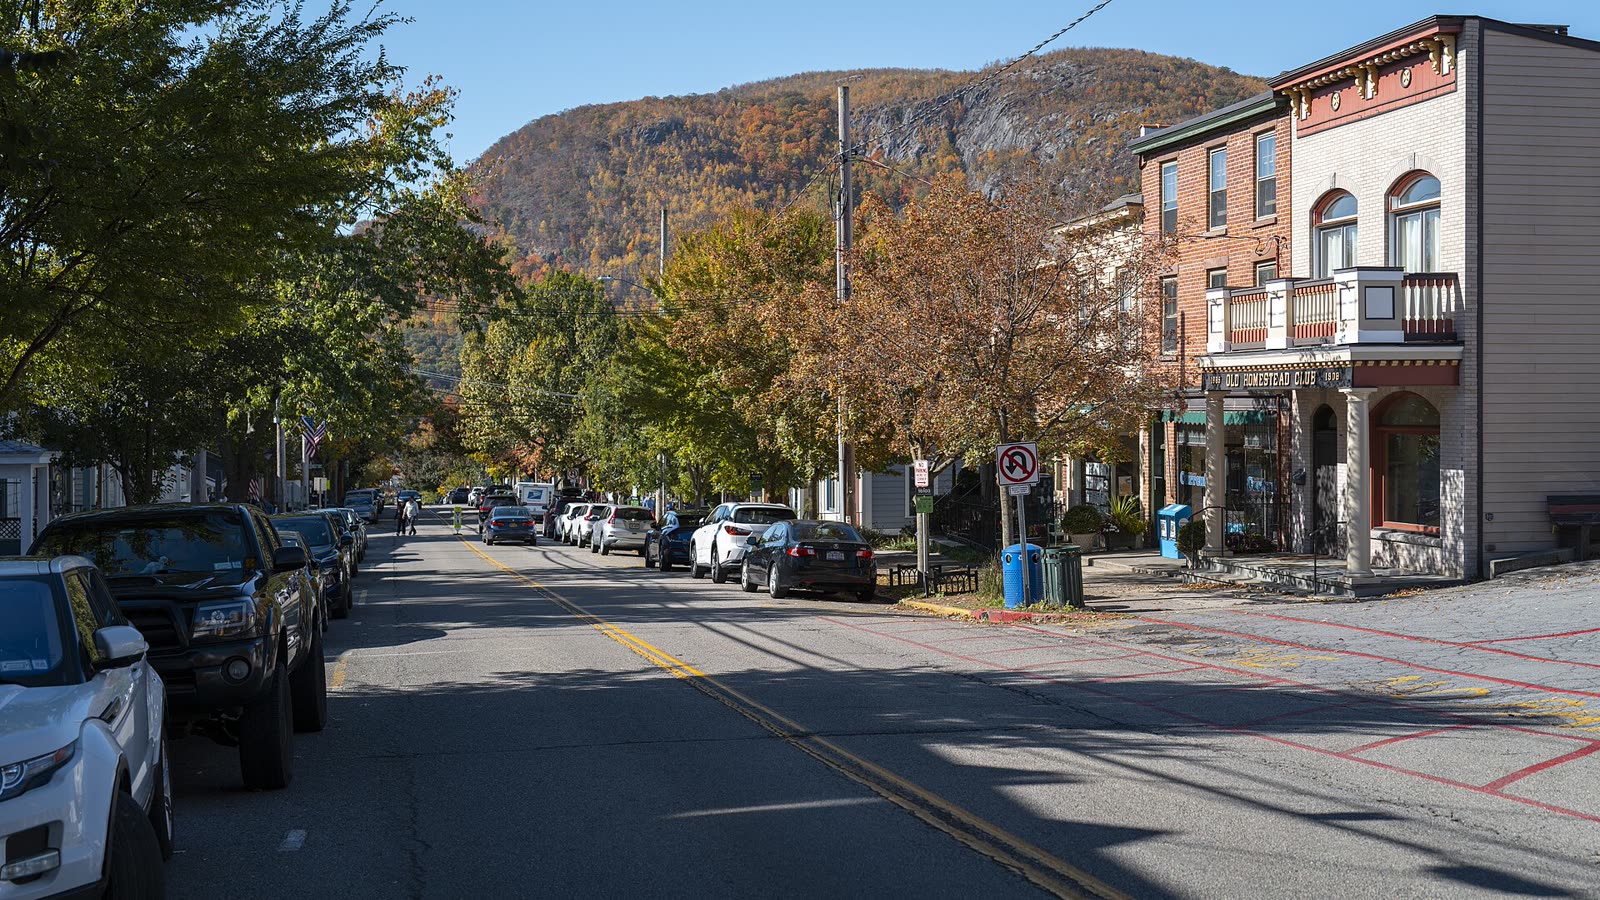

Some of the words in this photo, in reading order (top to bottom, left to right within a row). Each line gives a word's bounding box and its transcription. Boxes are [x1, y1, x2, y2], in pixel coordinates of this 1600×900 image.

[1225, 373, 1240, 387] OLD
[1243, 372, 1290, 387] HOMESTEAD
[1294, 371, 1316, 386] CLUB
[1325, 371, 1340, 381] 1908
